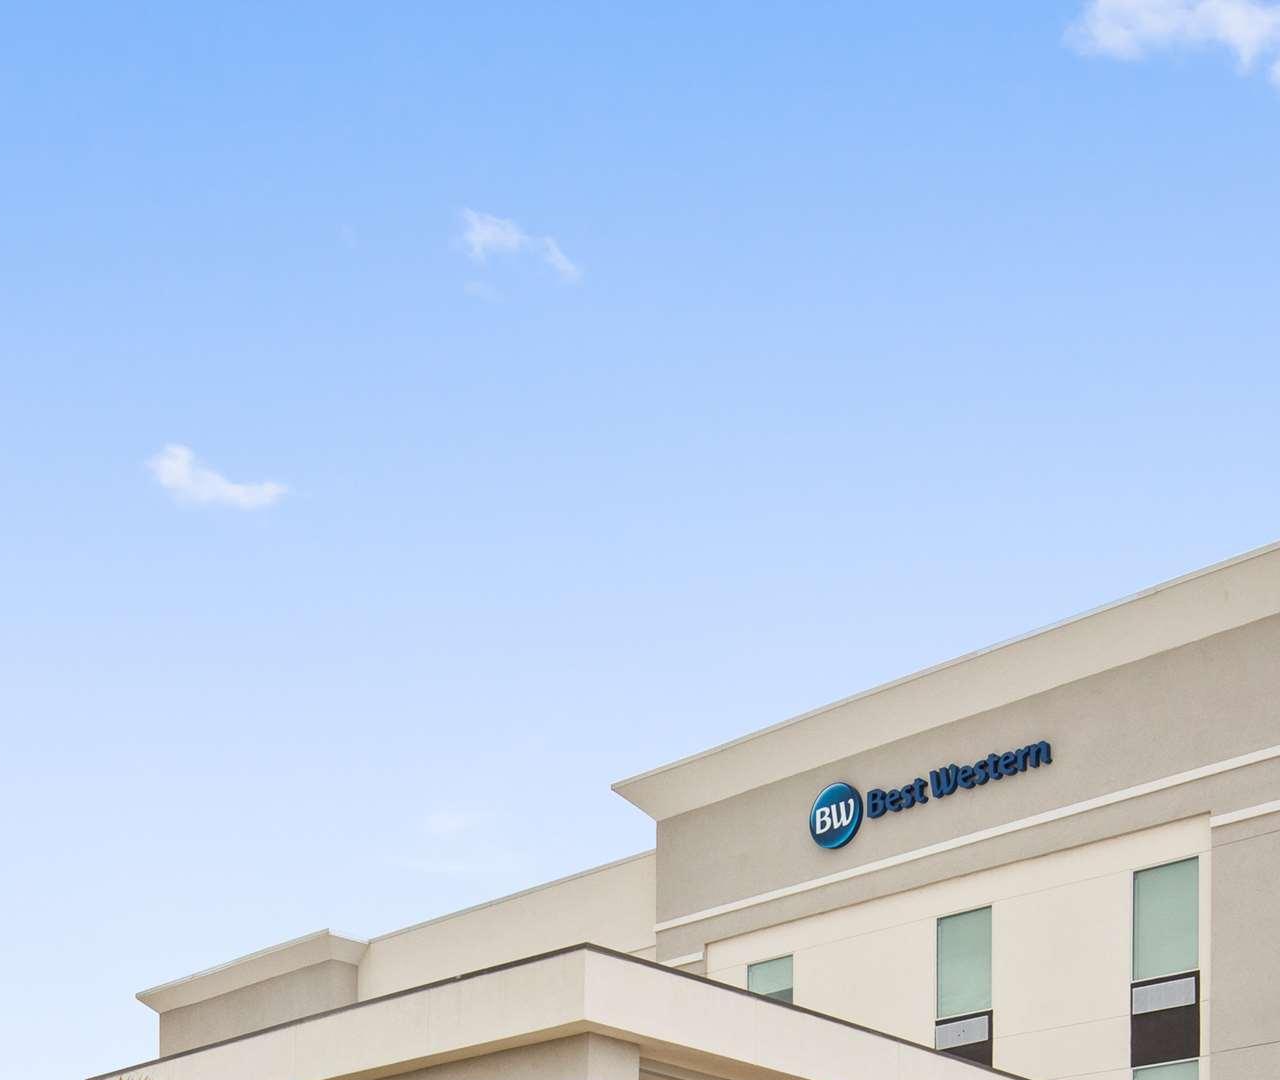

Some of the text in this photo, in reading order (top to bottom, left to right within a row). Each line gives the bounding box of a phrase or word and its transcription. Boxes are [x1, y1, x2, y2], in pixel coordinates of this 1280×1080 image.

[815, 740, 1053, 835] BW Best Western
